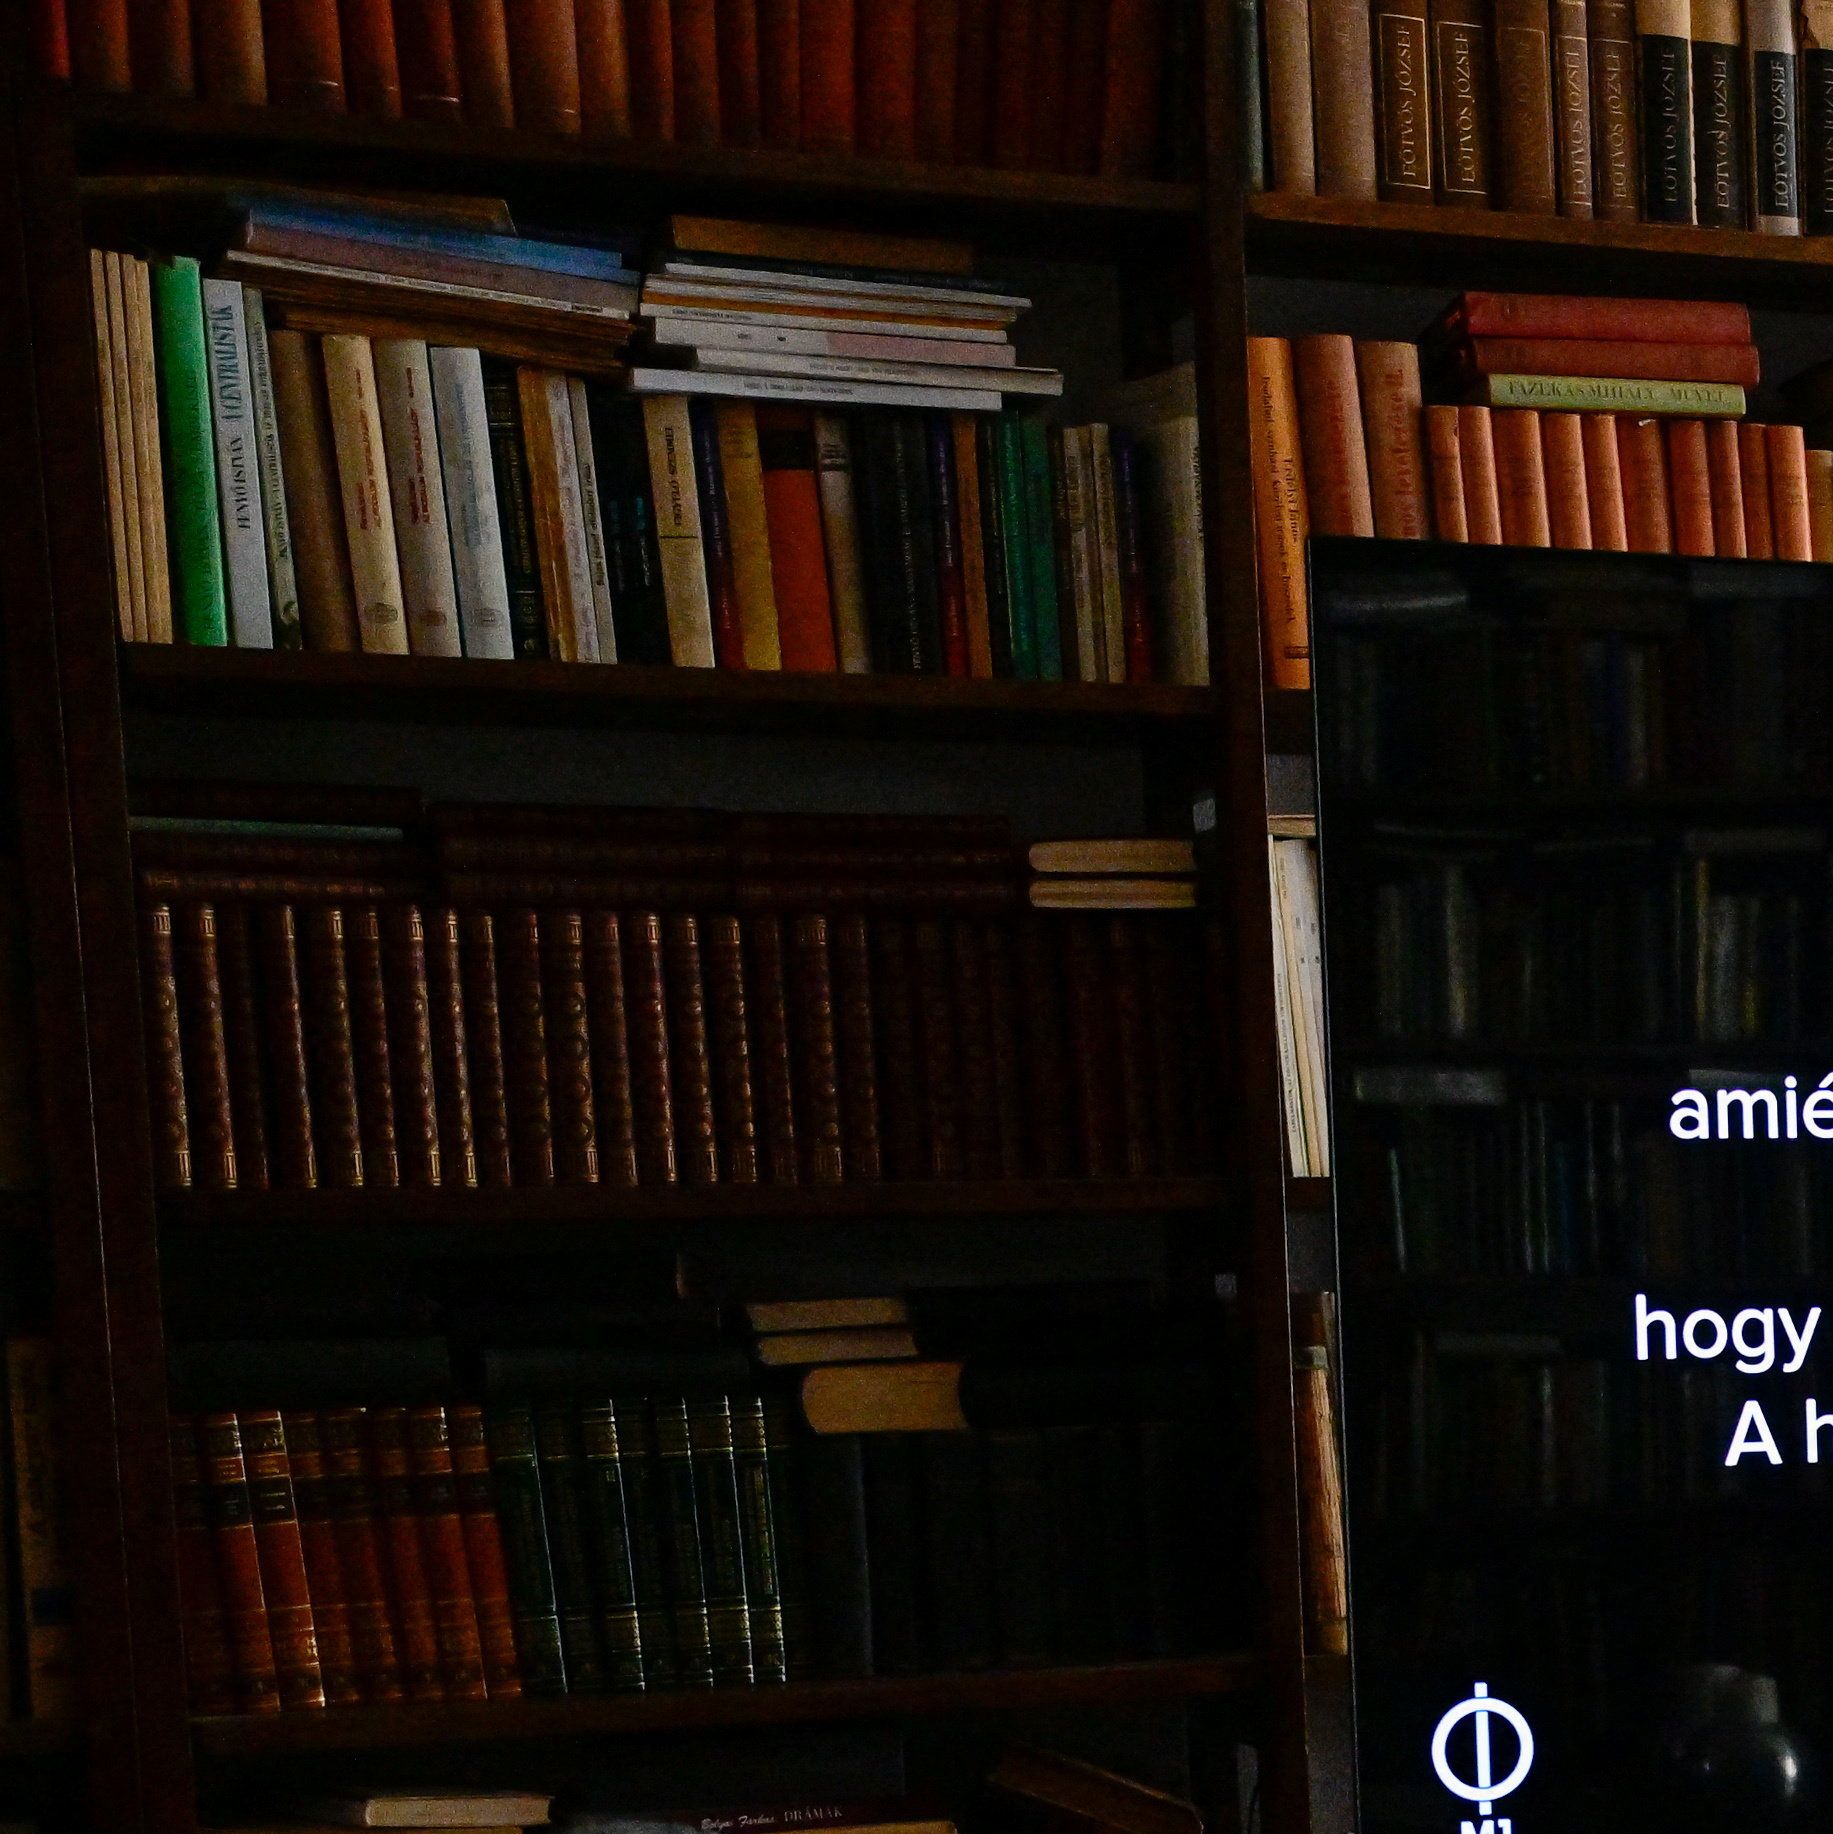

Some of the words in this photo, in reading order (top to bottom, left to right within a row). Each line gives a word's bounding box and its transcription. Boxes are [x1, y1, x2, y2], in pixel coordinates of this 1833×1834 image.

[212, 307, 242, 411] CENTRALISTÁK
[1636, 1294, 1821, 1373] hogy
[1725, 1400, 1783, 1466] A
[784, 1806, 843, 1822] DRÁMÁK
